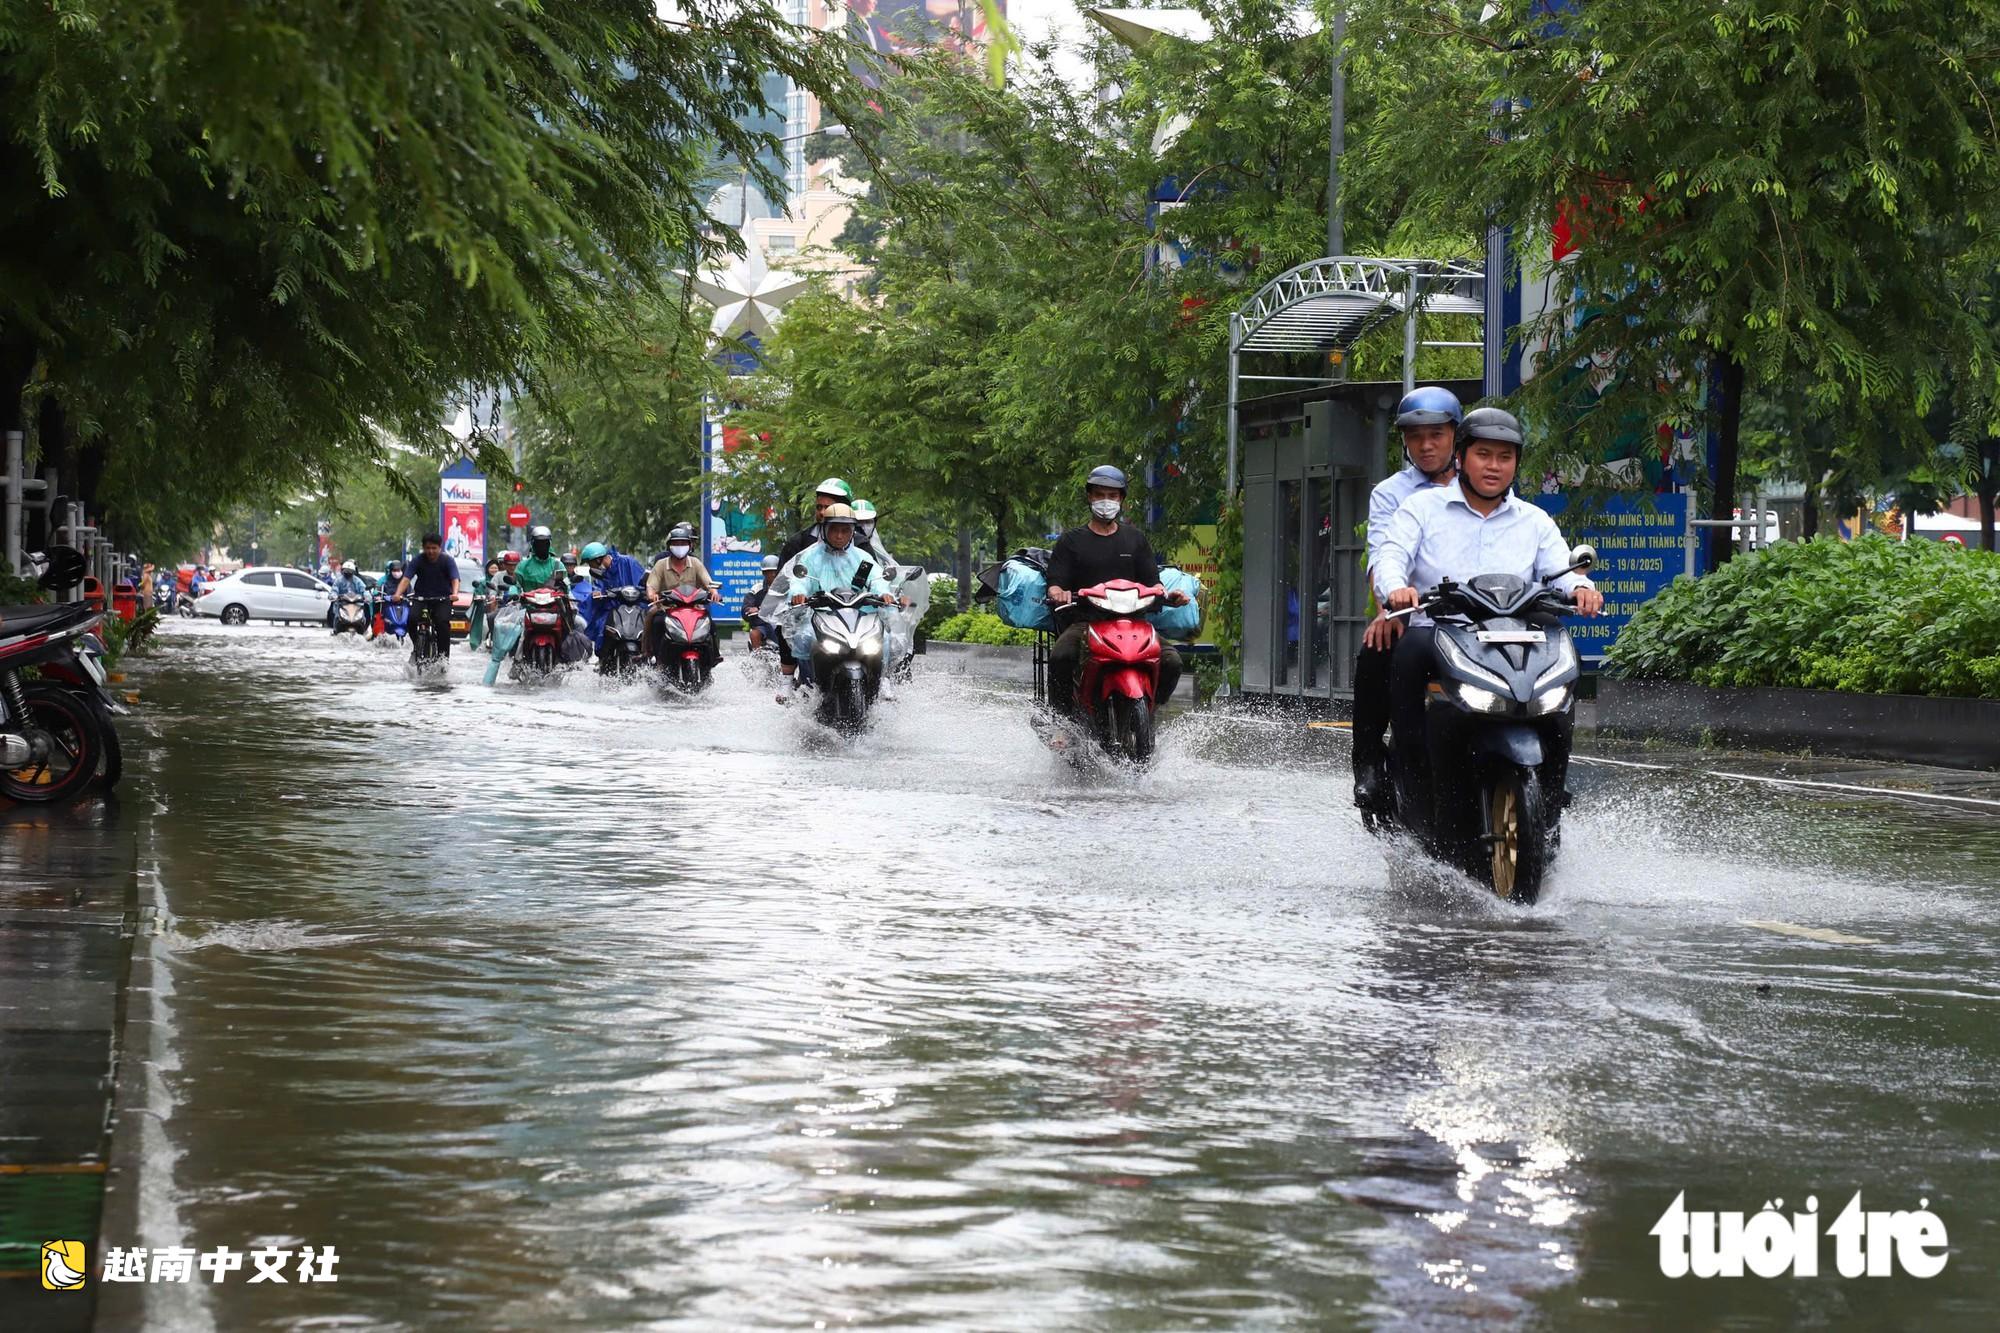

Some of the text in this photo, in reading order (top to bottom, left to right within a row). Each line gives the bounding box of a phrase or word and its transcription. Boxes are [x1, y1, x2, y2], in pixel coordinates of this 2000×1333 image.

[443, 484, 471, 499] Vikki
[1645, 514, 1655, 526] 80
[1657, 512, 1675, 526] NĂM
[1602, 533, 1629, 549] THÁNG
[1648, 533, 1676, 549] THÀNH
[1617, 557, 1663, 573] 19/8/2025)
[1618, 578, 1646, 592] KHÁNH
